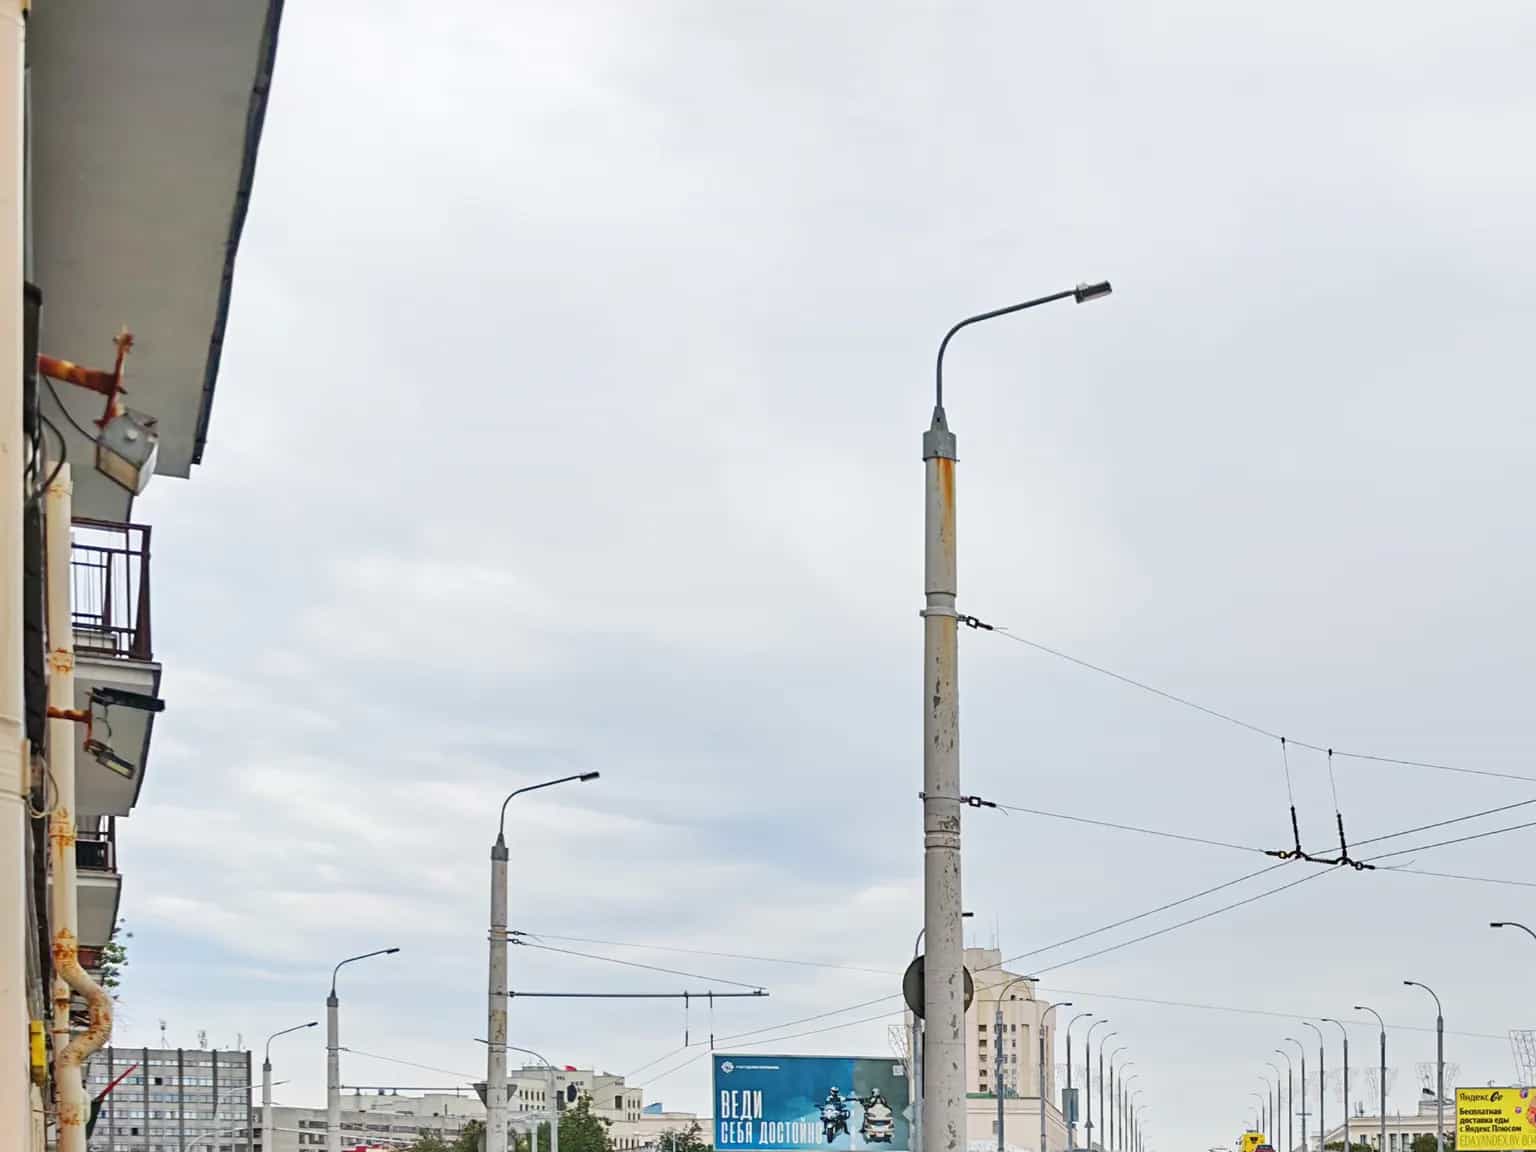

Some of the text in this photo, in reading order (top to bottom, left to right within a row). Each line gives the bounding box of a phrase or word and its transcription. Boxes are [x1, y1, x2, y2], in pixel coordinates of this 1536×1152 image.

[1460, 1093, 1488, 1102] Яндекс
[721, 1090, 762, 1120] ВЕДИ
[1459, 1107, 1502, 1115] Бесплатная
[1460, 1117, 1509, 1125] доставка еды
[721, 1119, 823, 1144] СЕБЯ ДОСТОЙНО
[1465, 1125, 1491, 1133] Яндекс
[1491, 1124, 1522, 1133] Плюсом
